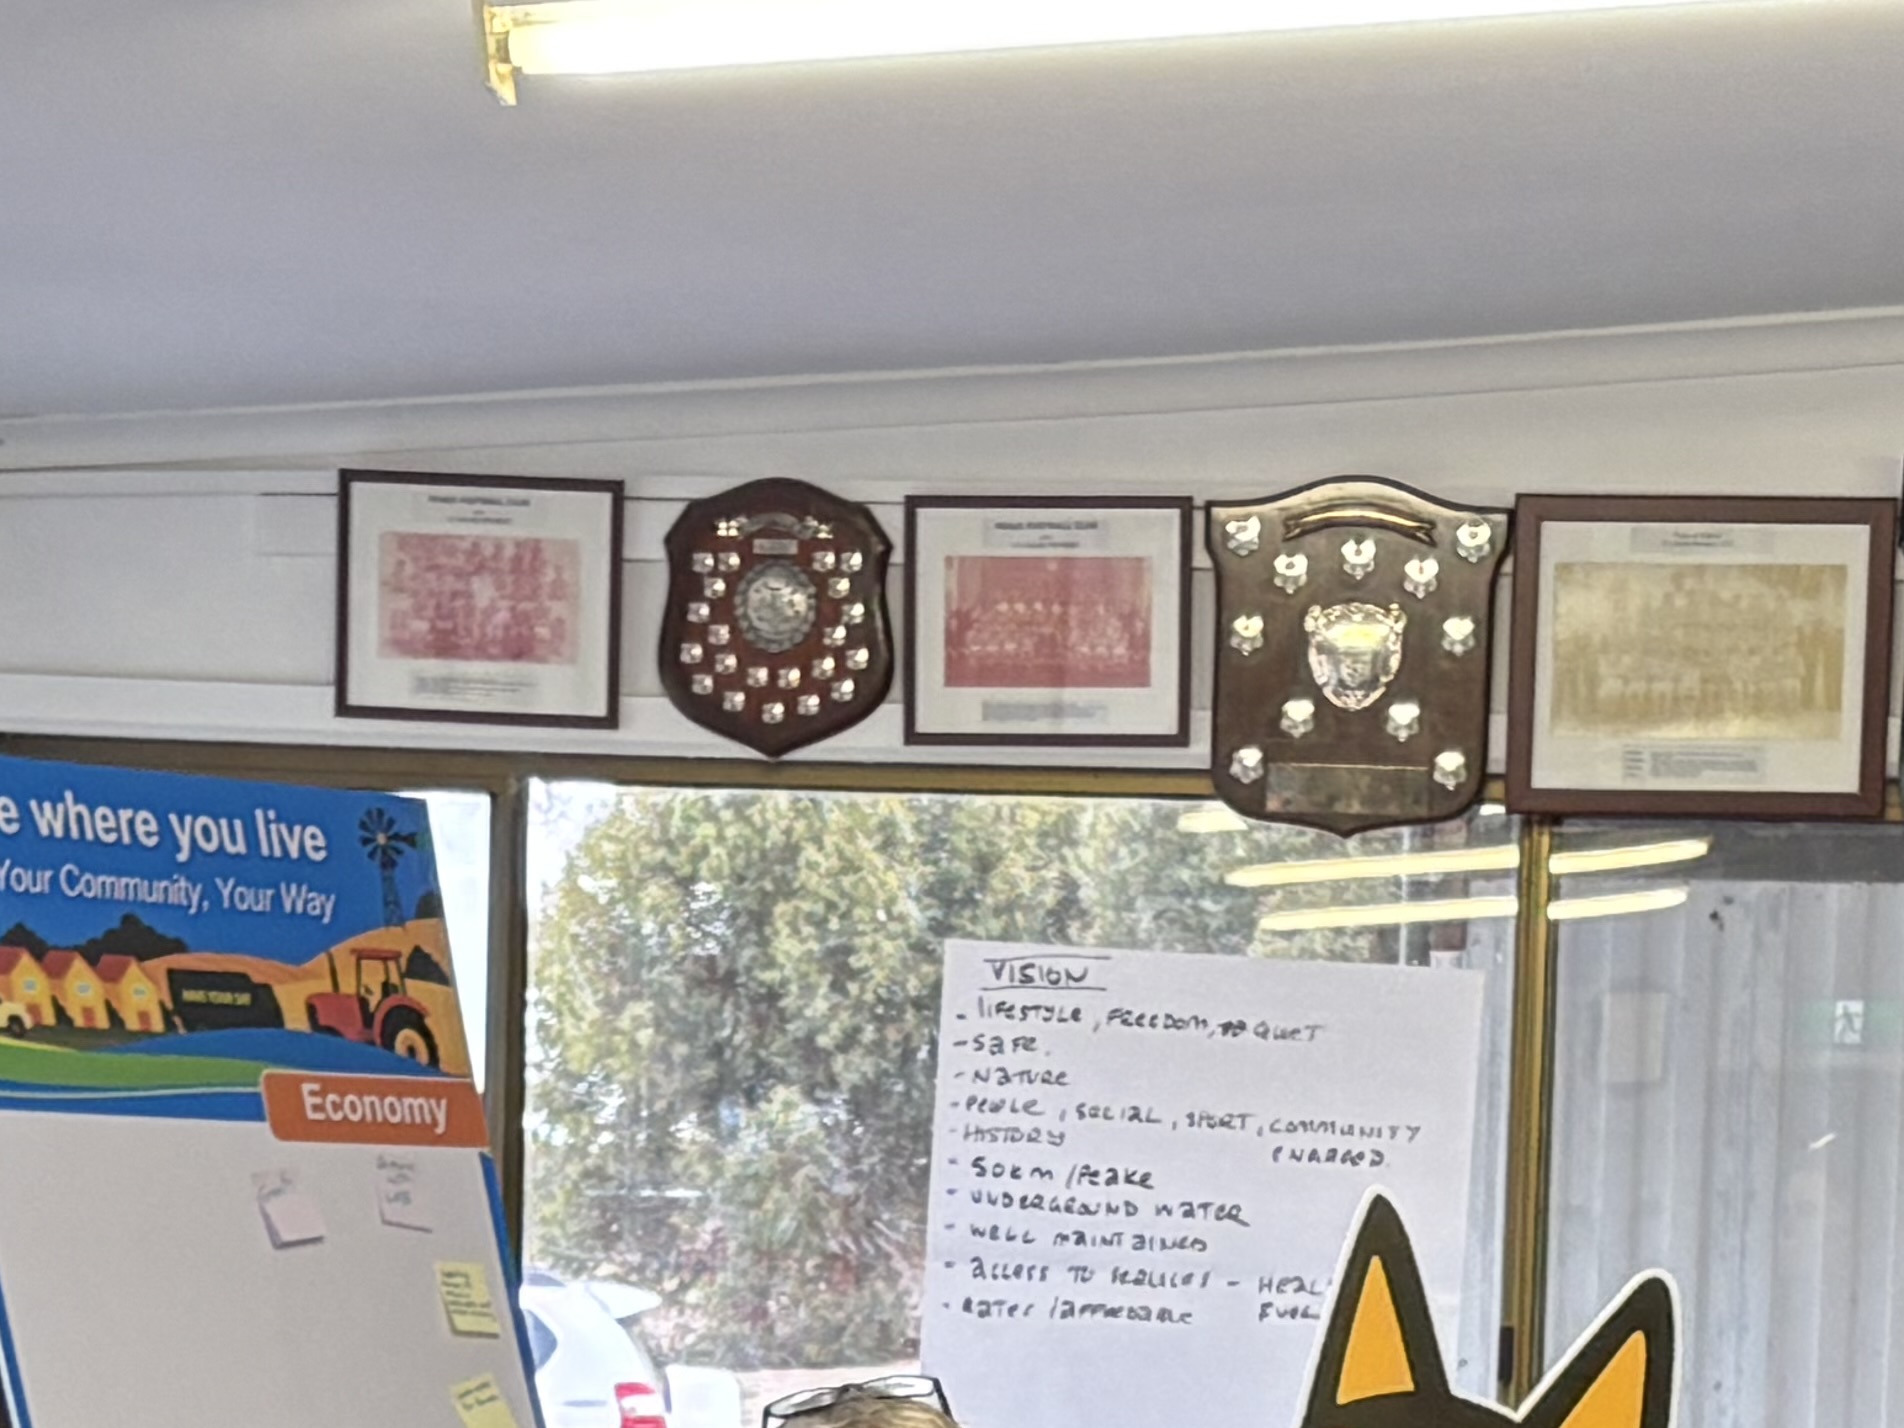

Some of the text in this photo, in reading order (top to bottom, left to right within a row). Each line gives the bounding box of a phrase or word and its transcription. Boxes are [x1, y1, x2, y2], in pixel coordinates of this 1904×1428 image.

[29, 789, 160, 847] where
[168, 811, 248, 864] you
[253, 808, 329, 863] live
[58, 862, 210, 914] Community,
[214, 877, 275, 914] Your
[279, 882, 336, 924] Way
[991, 960, 1089, 987] VISION
[300, 1082, 449, 1136] Economy
